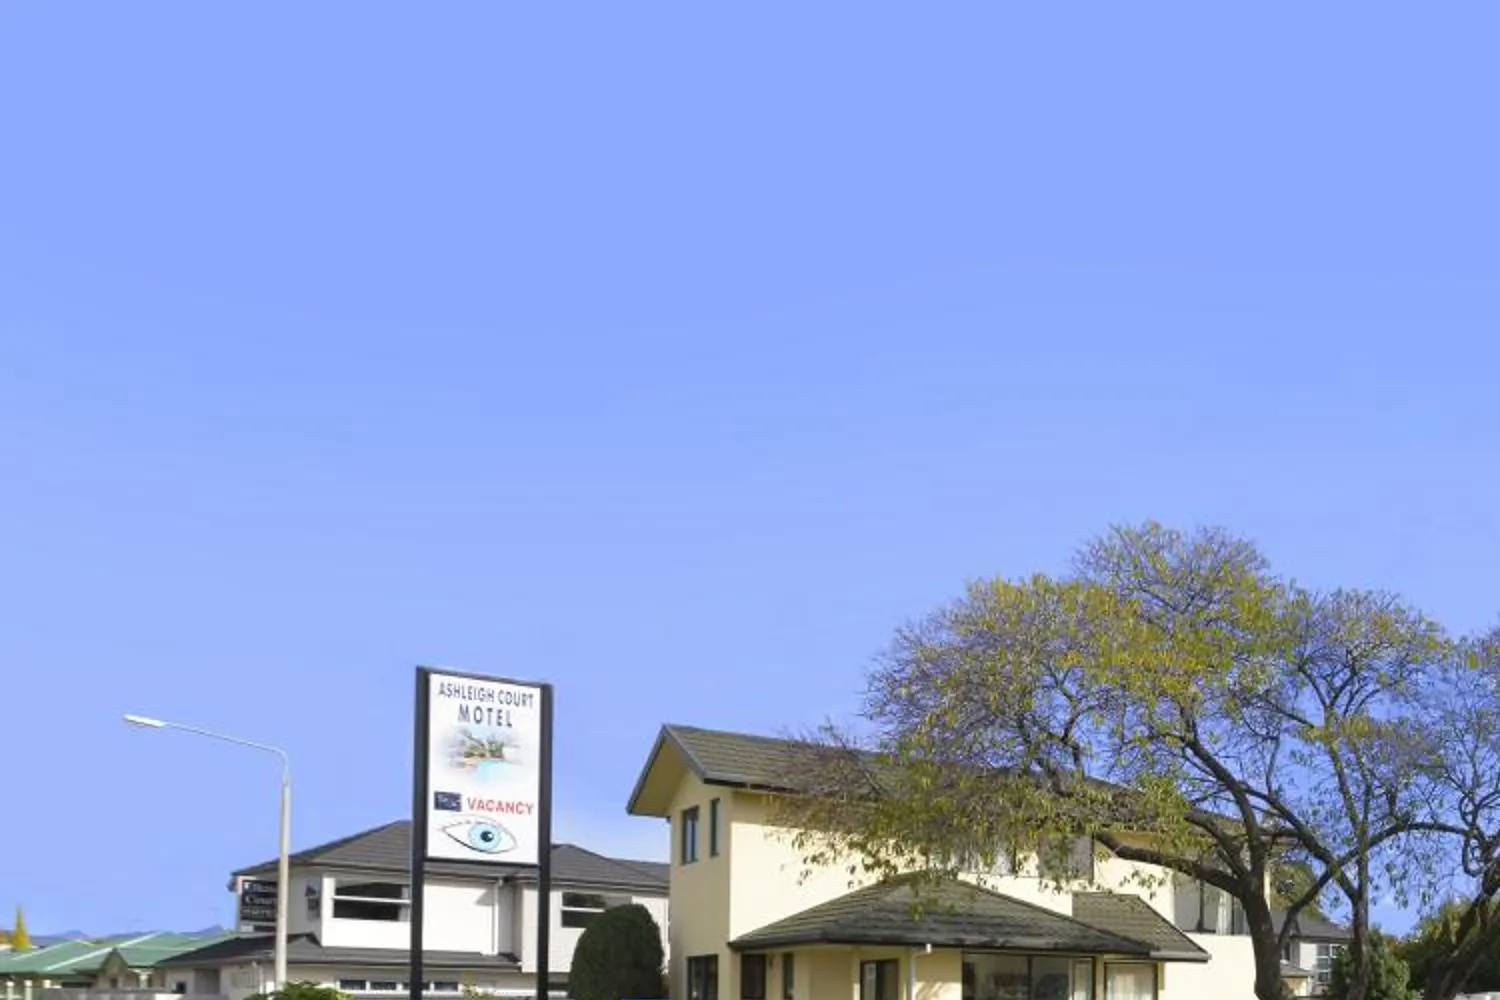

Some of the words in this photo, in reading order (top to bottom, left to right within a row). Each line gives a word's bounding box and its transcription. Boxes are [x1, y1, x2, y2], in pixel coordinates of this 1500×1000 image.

[439, 682, 495, 702] ASHLEIGH
[497, 689, 533, 708] COURT
[458, 704, 512, 728] MOTEL
[467, 798, 534, 815] VACANCY
